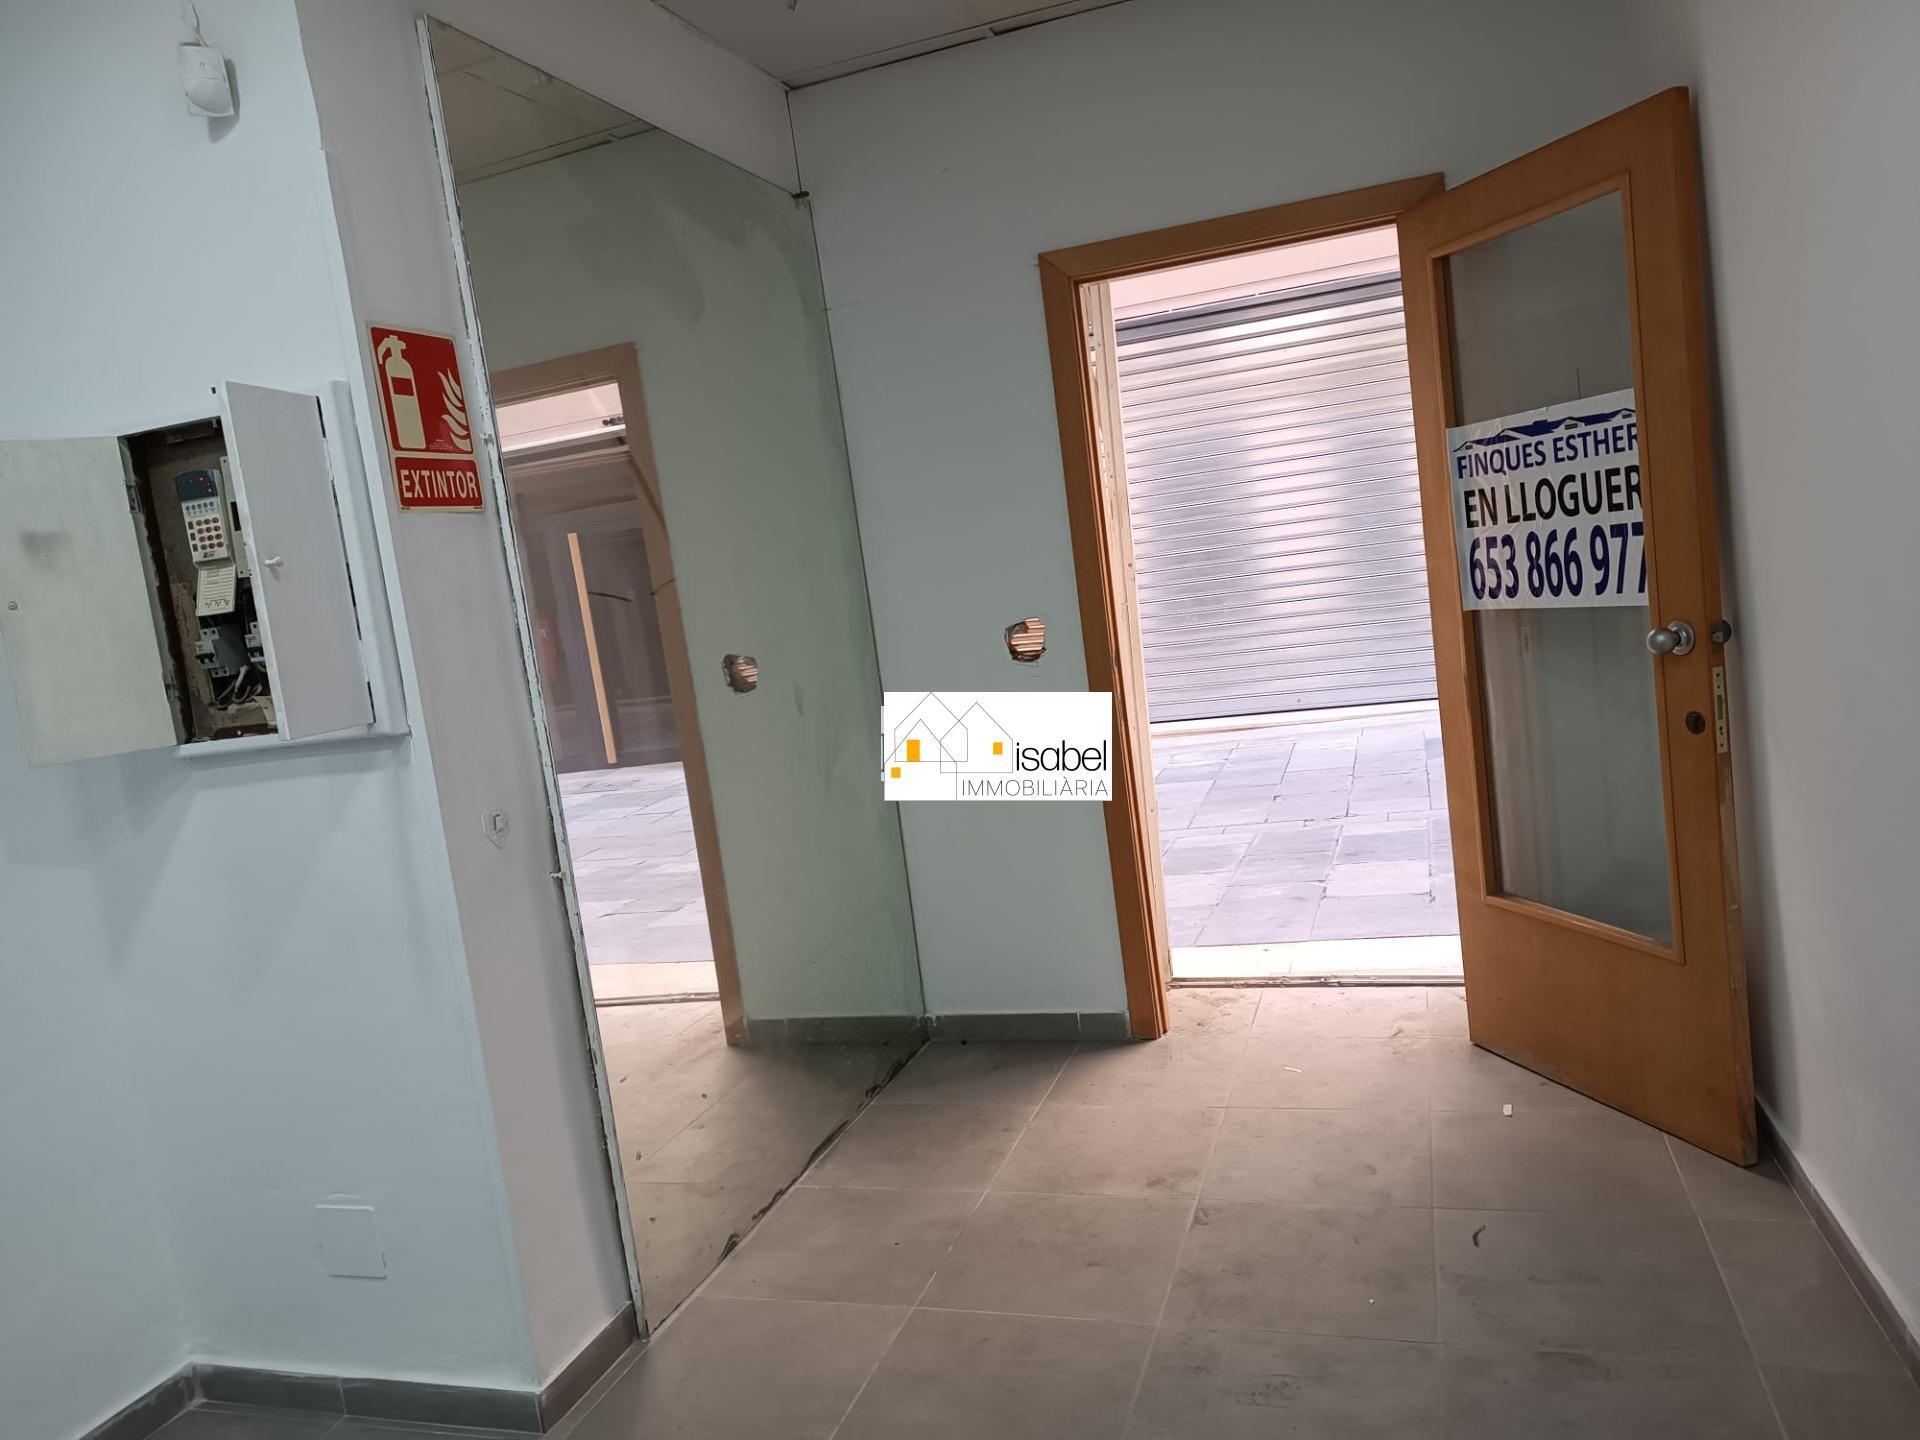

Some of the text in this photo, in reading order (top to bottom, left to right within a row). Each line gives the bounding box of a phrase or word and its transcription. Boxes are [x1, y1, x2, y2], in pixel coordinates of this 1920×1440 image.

[1457, 422, 1639, 479] FINQUES ESTHER
[400, 469, 478, 498] EXTINTOR
[1464, 464, 1643, 528] EN LLOGUER
[1469, 521, 1648, 600] 653 866 977
